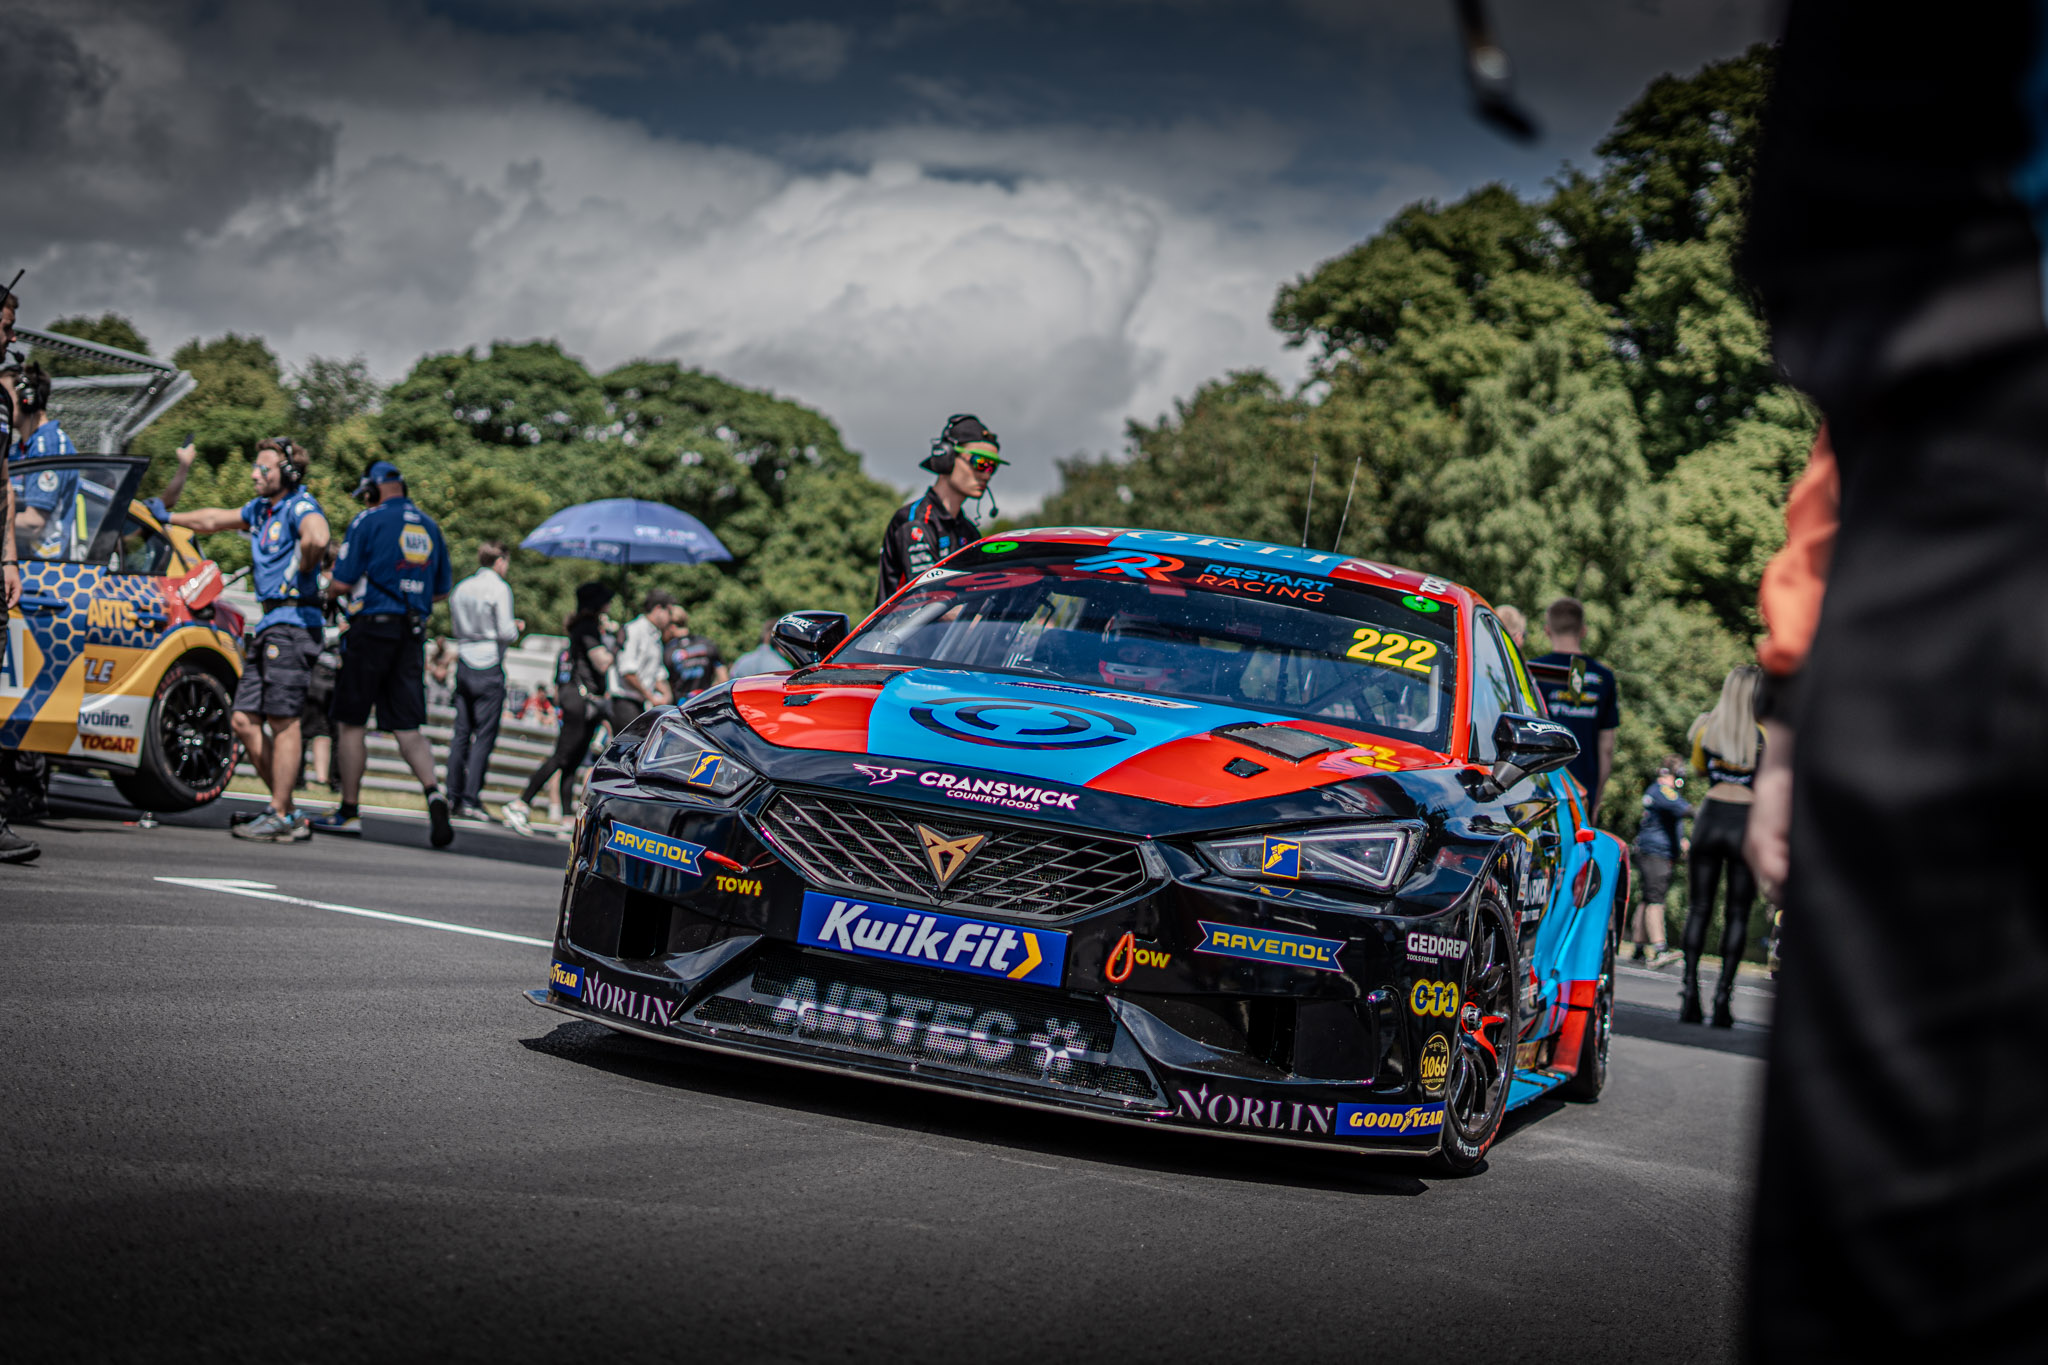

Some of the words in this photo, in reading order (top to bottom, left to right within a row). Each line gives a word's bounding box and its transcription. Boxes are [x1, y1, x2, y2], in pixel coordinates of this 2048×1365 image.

[1195, 573, 1326, 603] RACING
[1203, 563, 1334, 592] RESTART
[1346, 628, 1438, 674] 222
[84, 658, 115, 683] LE
[919, 770, 1080, 811] CRANSWICK
[946, 788, 1000, 805] COUNTRY
[1000, 797, 1041, 812] FOODS
[614, 829, 694, 865] RAVENOL
[716, 875, 756, 895] TOW
[1212, 931, 1331, 962] RAVENOL
[1407, 932, 1460, 958] GEDORE
[582, 971, 674, 1027] NORLIN
[1422, 1055, 1448, 1078] 1066
[1174, 1083, 1334, 1134] NORLIN
